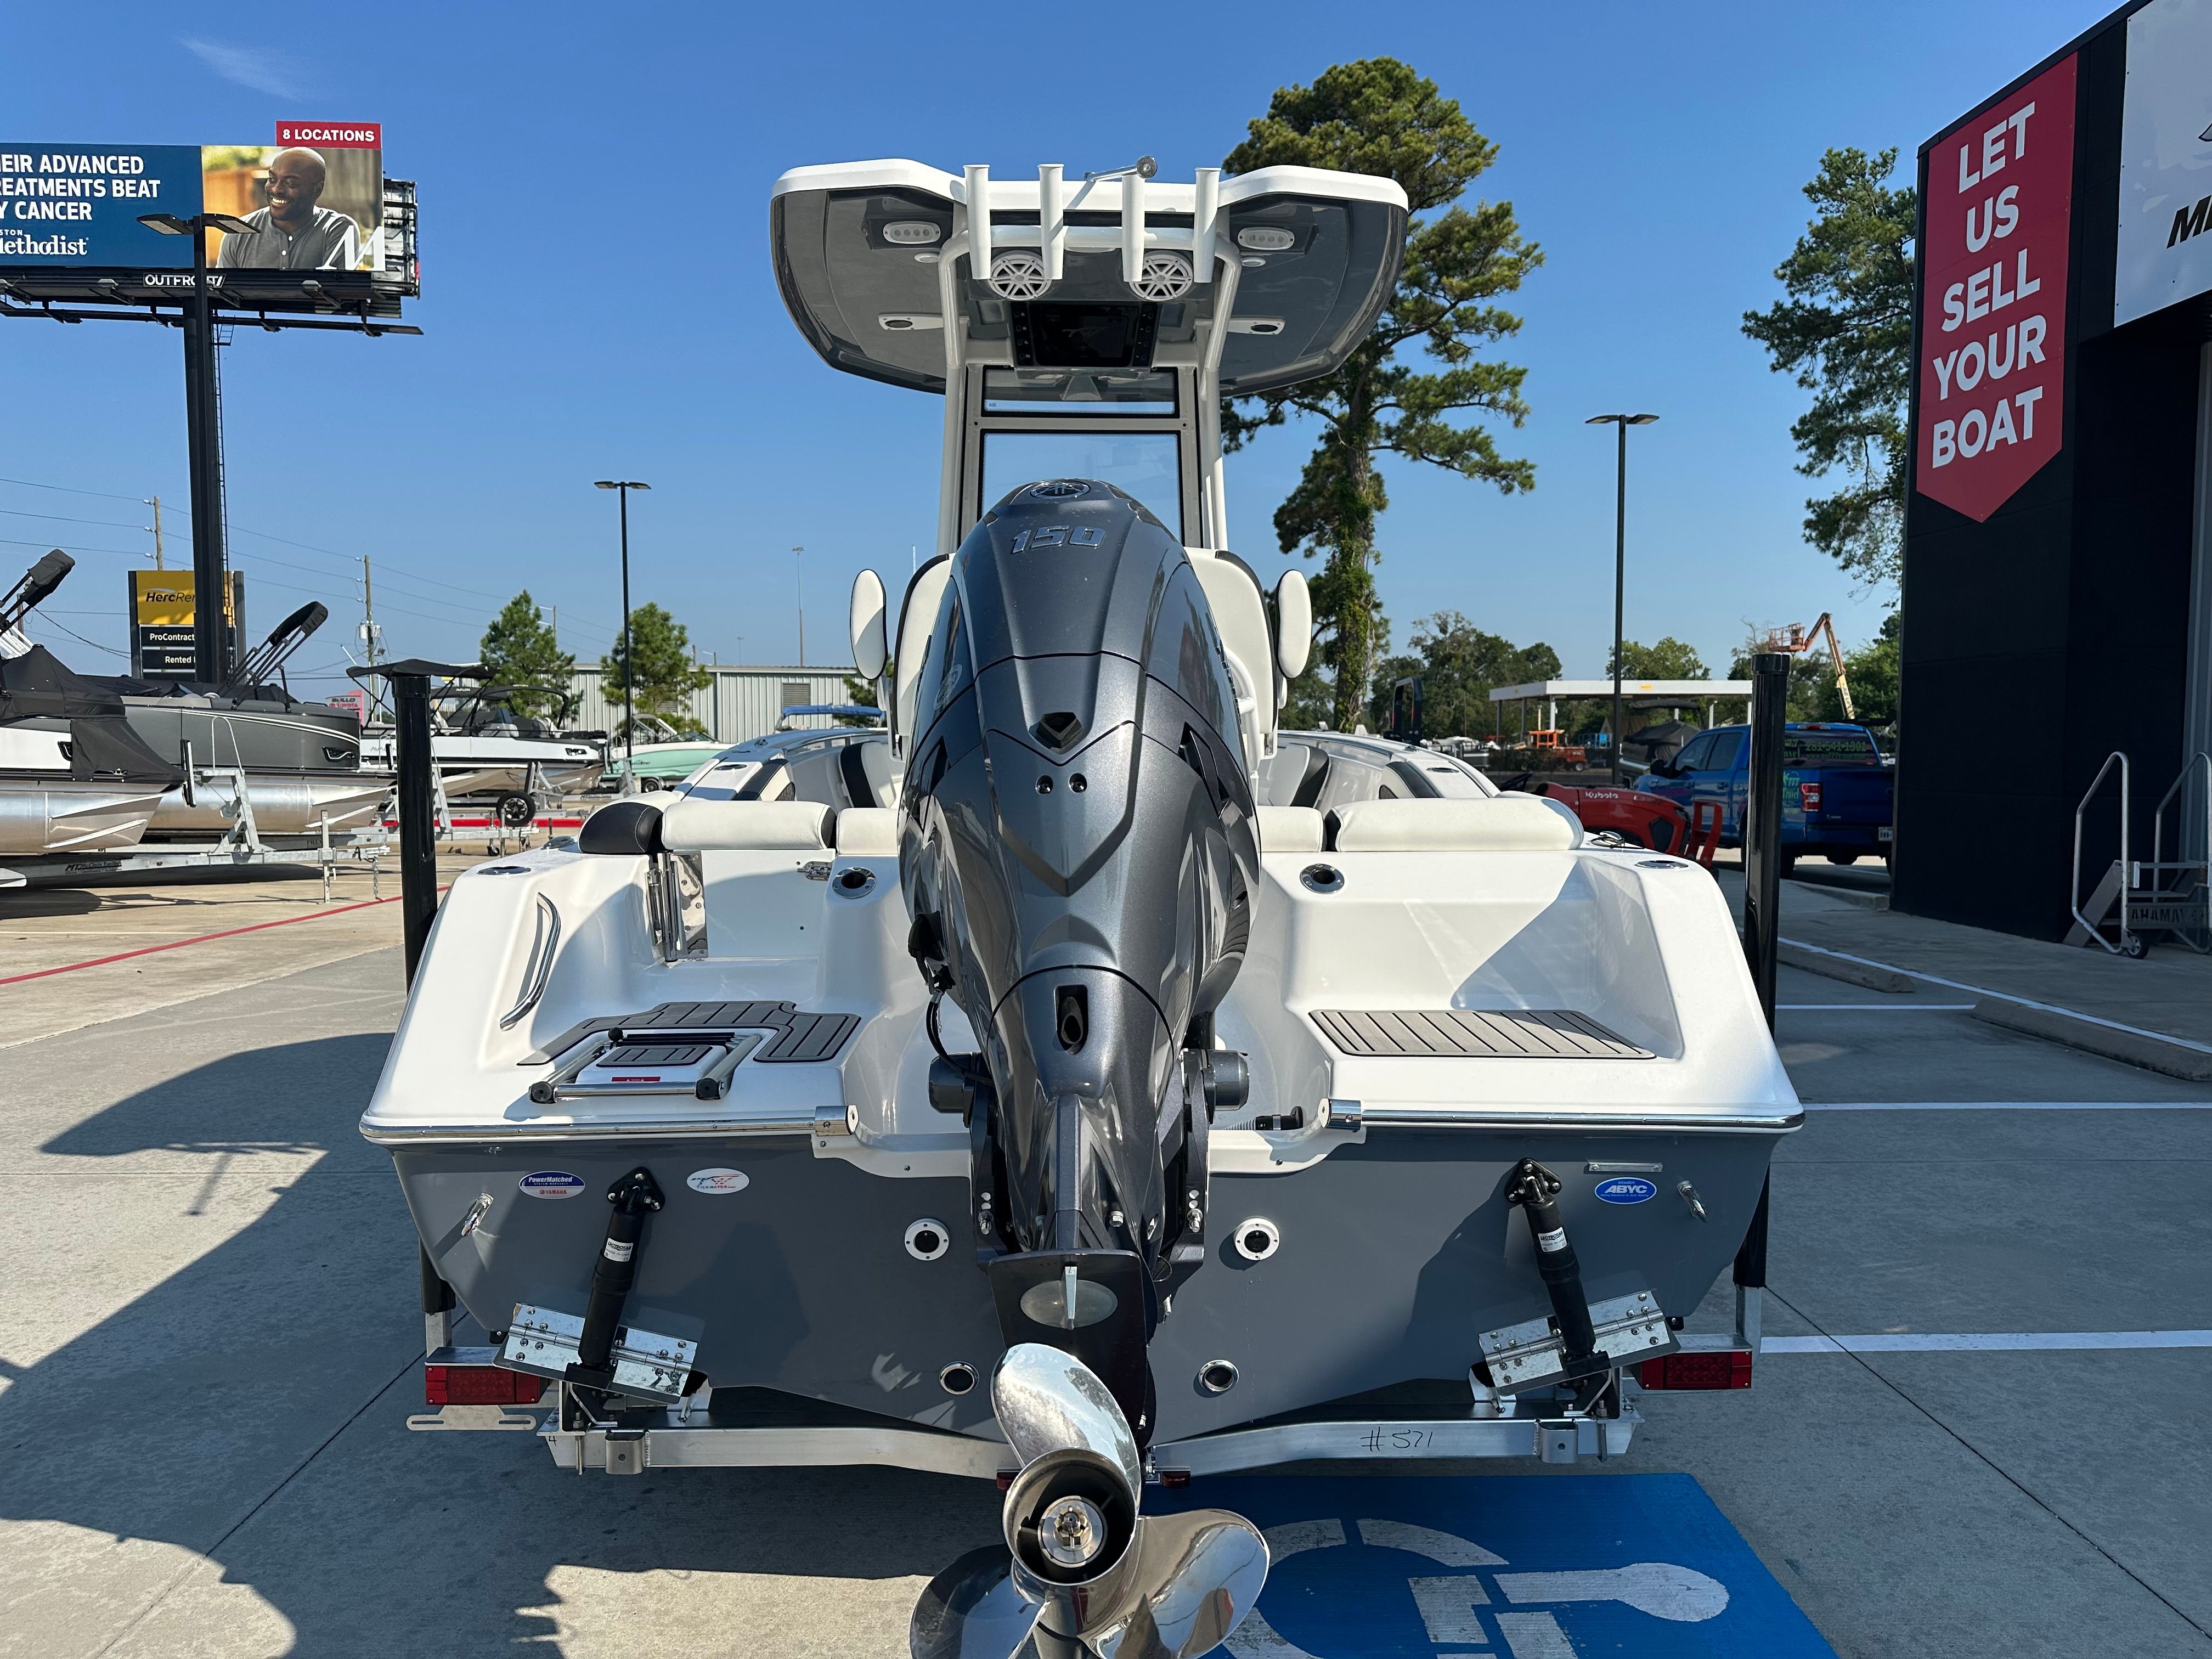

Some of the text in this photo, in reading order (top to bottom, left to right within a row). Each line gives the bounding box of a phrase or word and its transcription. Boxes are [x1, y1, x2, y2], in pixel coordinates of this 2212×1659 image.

[283, 129, 375, 142] 8 LOCATIONS
[1959, 101, 2035, 194] LET
[0, 154, 144, 174] EIR ADVANCED
[0, 178, 160, 198] EATMENTS BEAT
[15, 201, 92, 220] CANCER
[1966, 185, 2019, 253] US
[0, 234, 88, 255] ethodist
[1942, 248, 2040, 332] SELL
[1933, 315, 2046, 400] YOUR
[1932, 386, 2043, 469] BOAT
[1010, 525, 1105, 555] 150
[1604, 1185, 1647, 1194] ABYC
